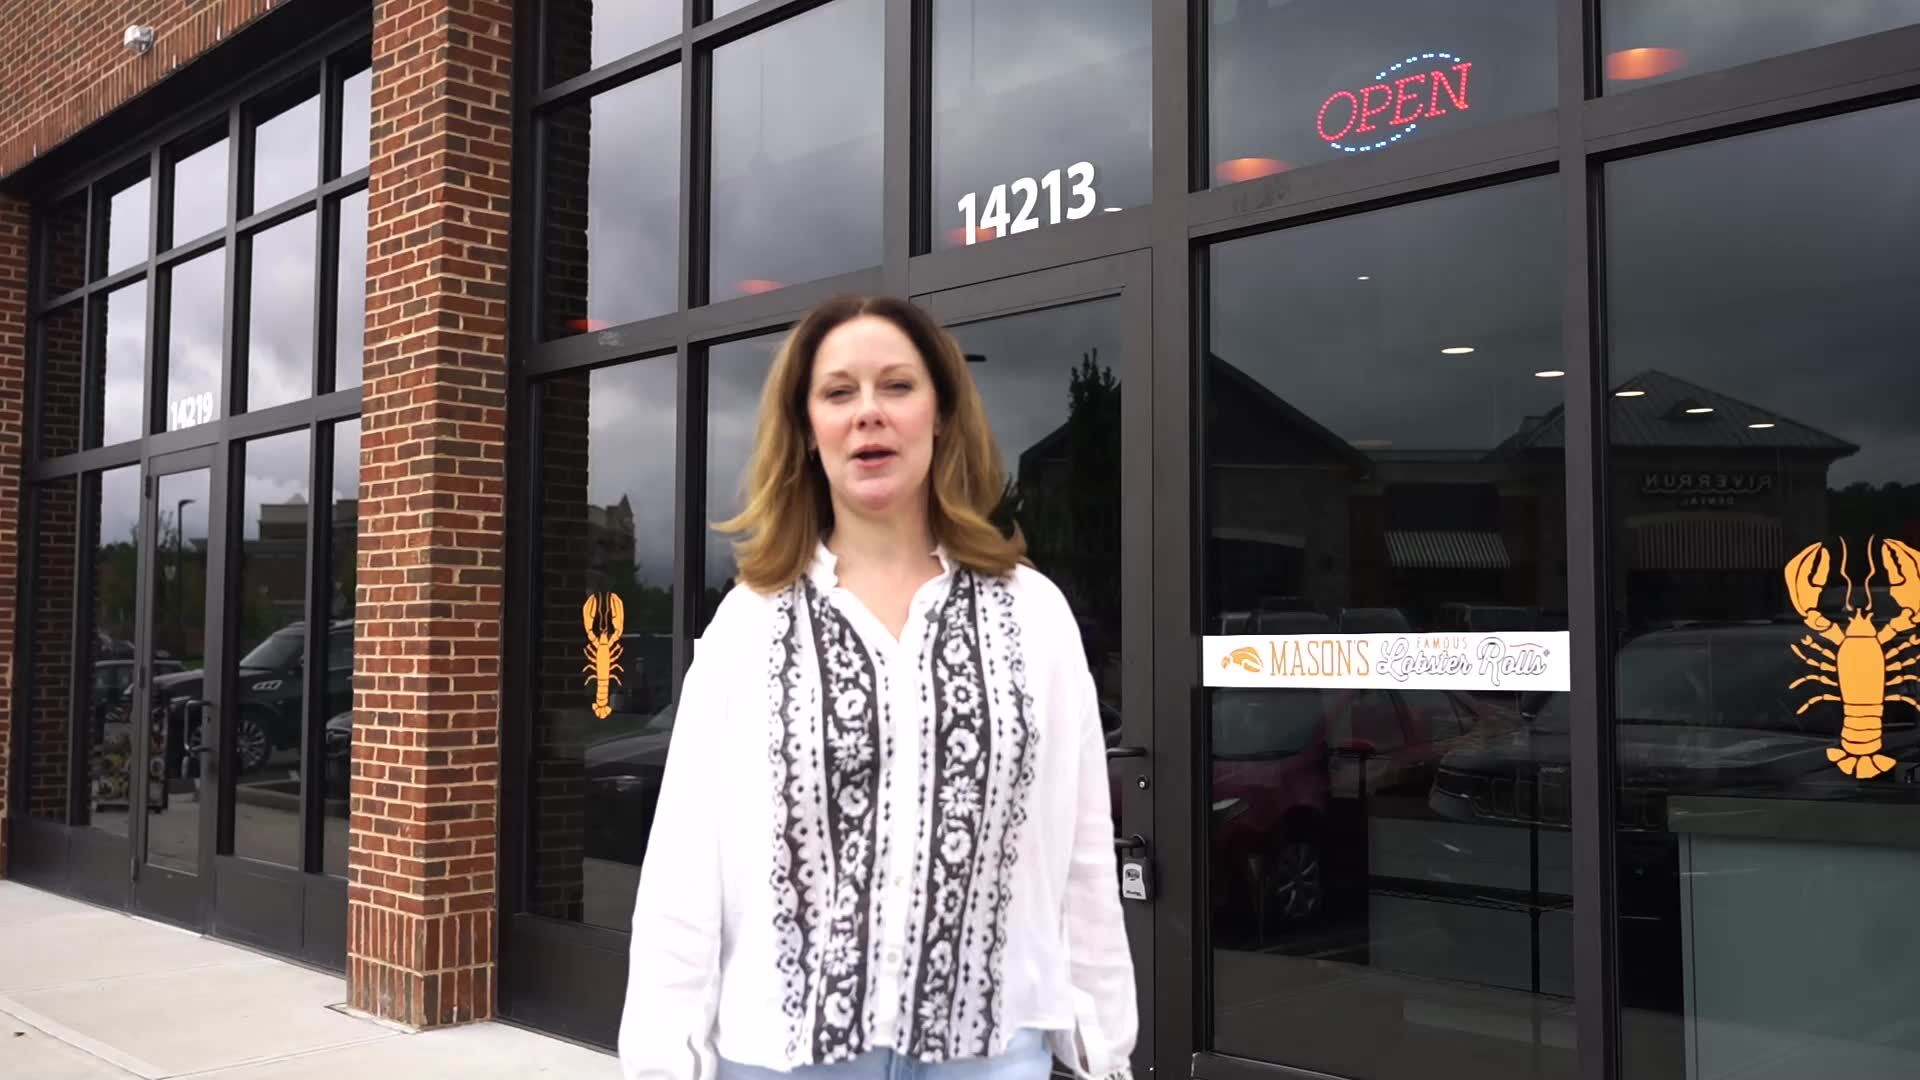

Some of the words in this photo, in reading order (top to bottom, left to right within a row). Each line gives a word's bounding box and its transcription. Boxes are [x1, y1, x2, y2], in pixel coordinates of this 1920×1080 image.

[1316, 62, 1472, 142] OPEN
[957, 161, 1097, 246] 14213
[170, 391, 213, 431] 14219
[1269, 640, 1370, 677] MASON'S
[1376, 637, 1473, 683] Lobster
[1416, 637, 1468, 650] FAMOUS
